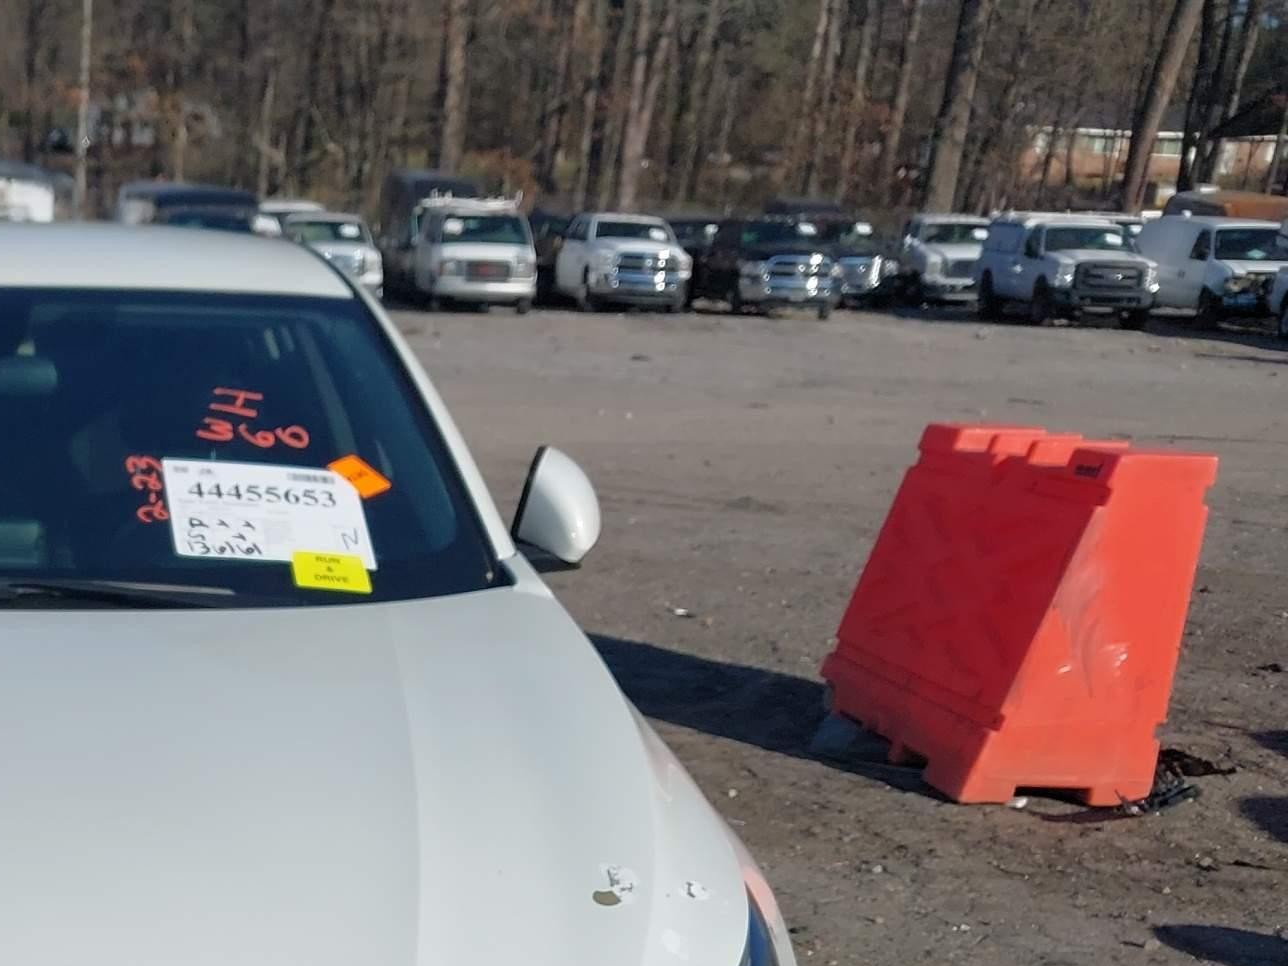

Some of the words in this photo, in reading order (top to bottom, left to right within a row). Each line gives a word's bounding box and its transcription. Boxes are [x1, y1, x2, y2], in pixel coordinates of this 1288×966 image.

[187, 482, 338, 508] 44455653
[314, 555, 342, 565] RUN
[313, 574, 350, 584] DRIVE
